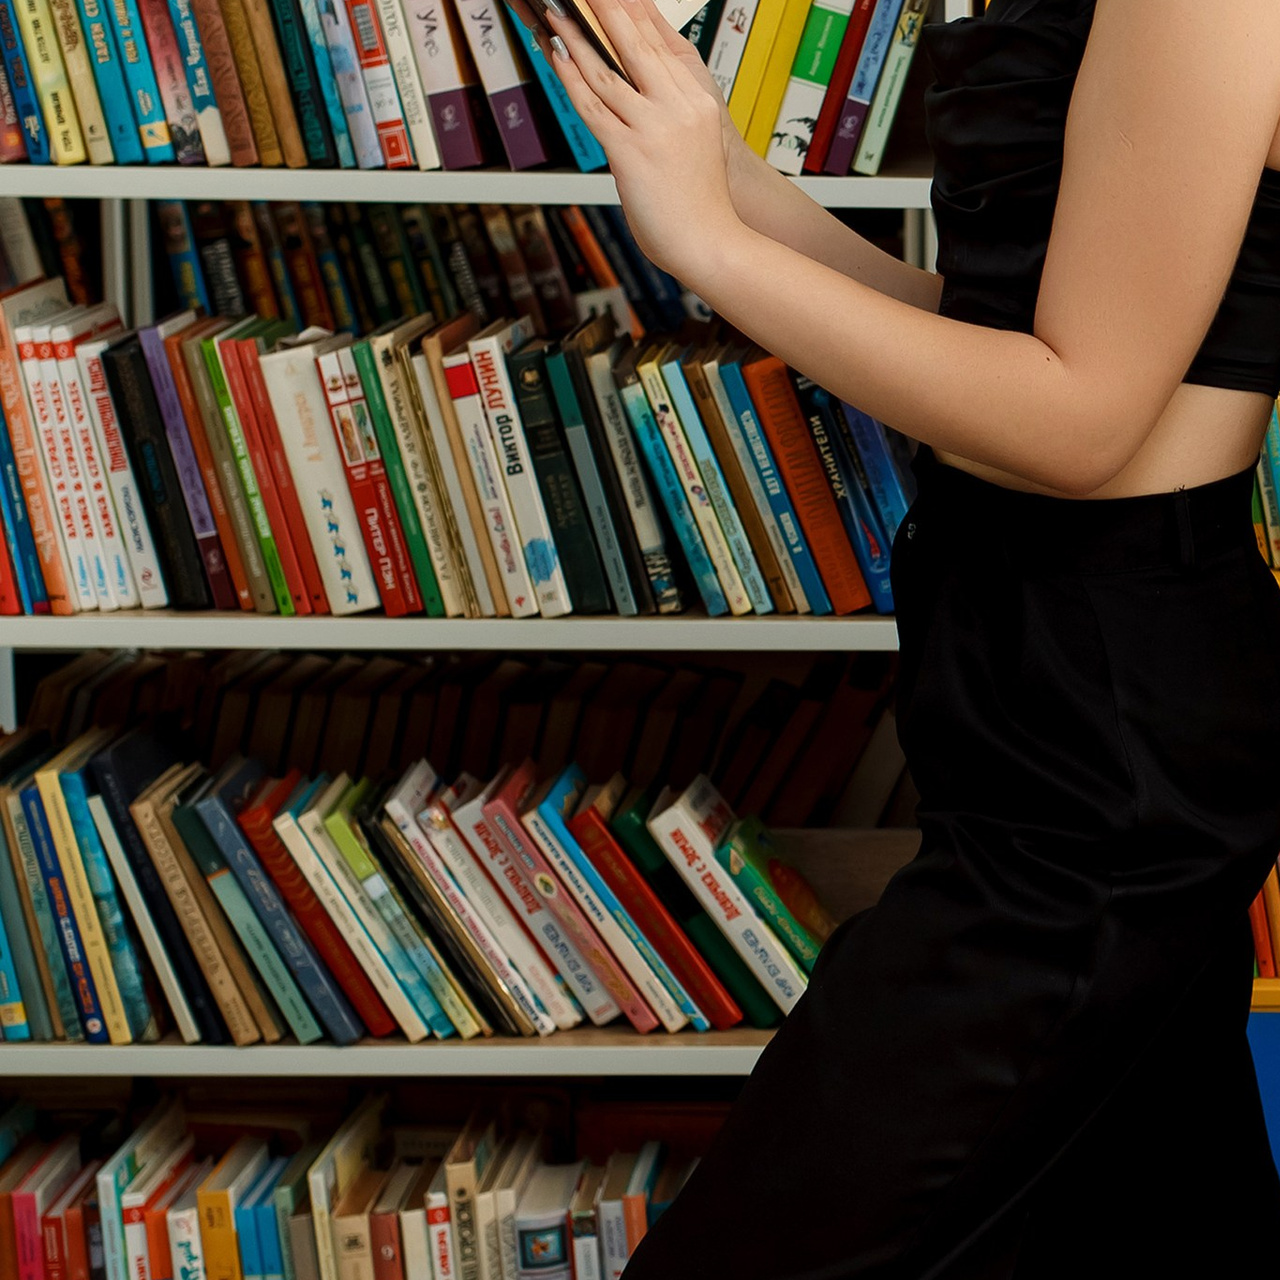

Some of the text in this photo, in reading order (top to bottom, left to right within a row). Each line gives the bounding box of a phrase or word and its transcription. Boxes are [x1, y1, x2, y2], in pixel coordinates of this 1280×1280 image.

[475, 350, 506, 409] ЛУНИН
[496, 415, 523, 475] Виктор
[810, 415, 847, 499] ХРАНИТЕЛИ
[365, 508, 396, 590] ПИТЕР ПЭН
